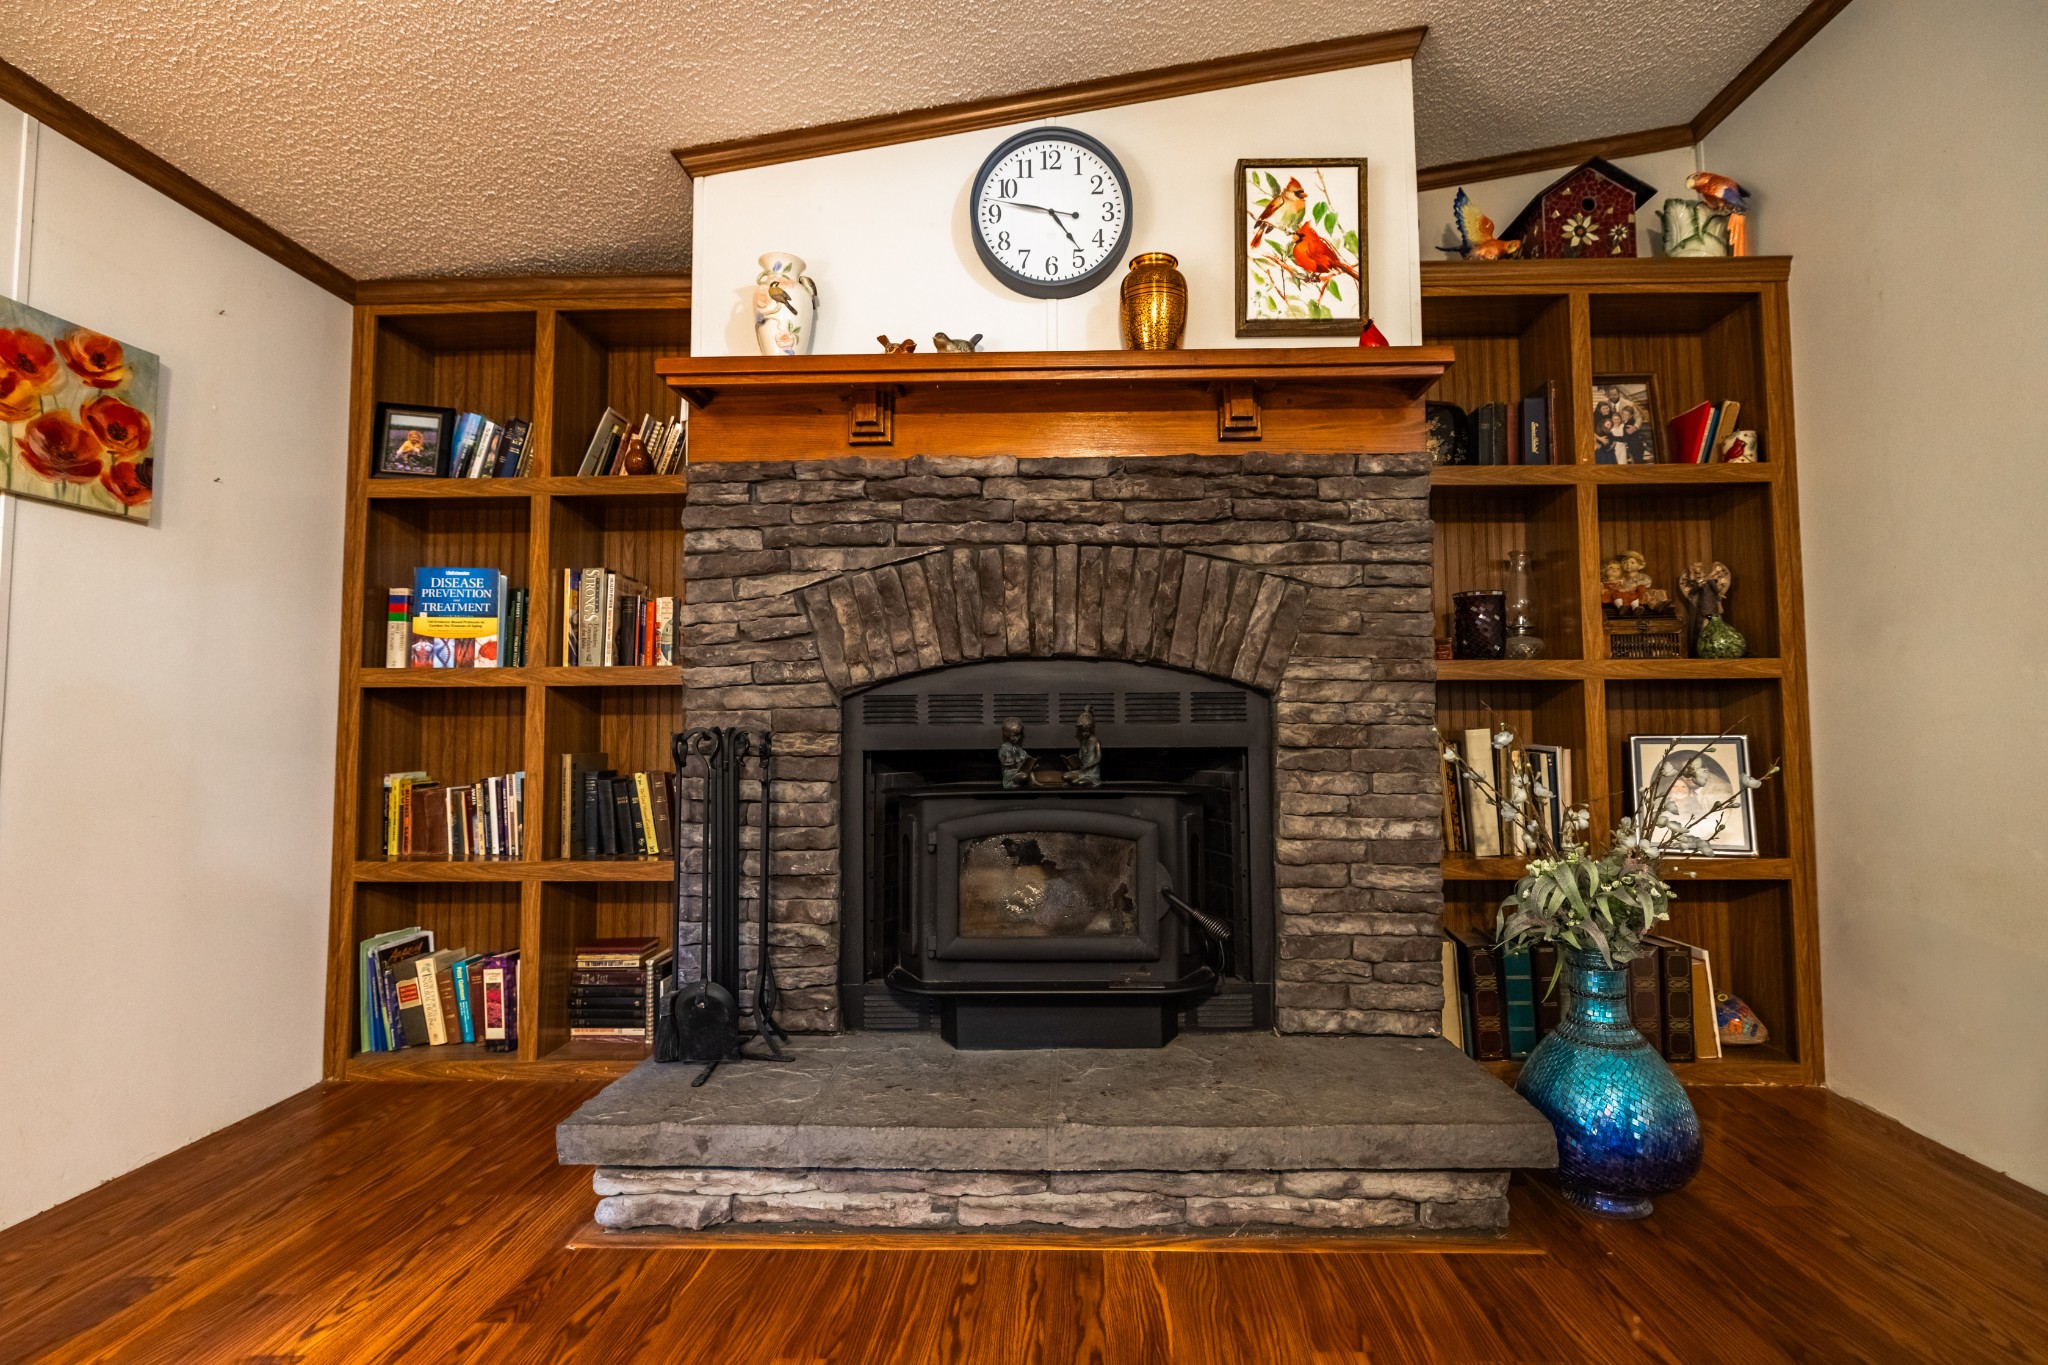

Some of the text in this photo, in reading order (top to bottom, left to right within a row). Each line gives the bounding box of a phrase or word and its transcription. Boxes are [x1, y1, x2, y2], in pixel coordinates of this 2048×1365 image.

[1016, 159, 1034, 178] 11
[1040, 150, 1062, 170] 12
[1074, 156, 1083, 175] 1
[998, 179, 1017, 198] 10
[1090, 175, 1104, 194] 2
[989, 204, 1001, 224] 9
[1102, 202, 1114, 221] 3
[998, 231, 1010, 250] 8
[1092, 229, 1104, 248] 4
[1018, 250, 1030, 269] 7
[1046, 256, 1058, 275] 6
[1073, 249, 1085, 268] 5
[431, 578, 484, 588] DISEASE
[422, 589, 492, 598] PREVENTION
[584, 569, 600, 621] STRONG'S
[422, 603, 490, 612] TREATMENT
